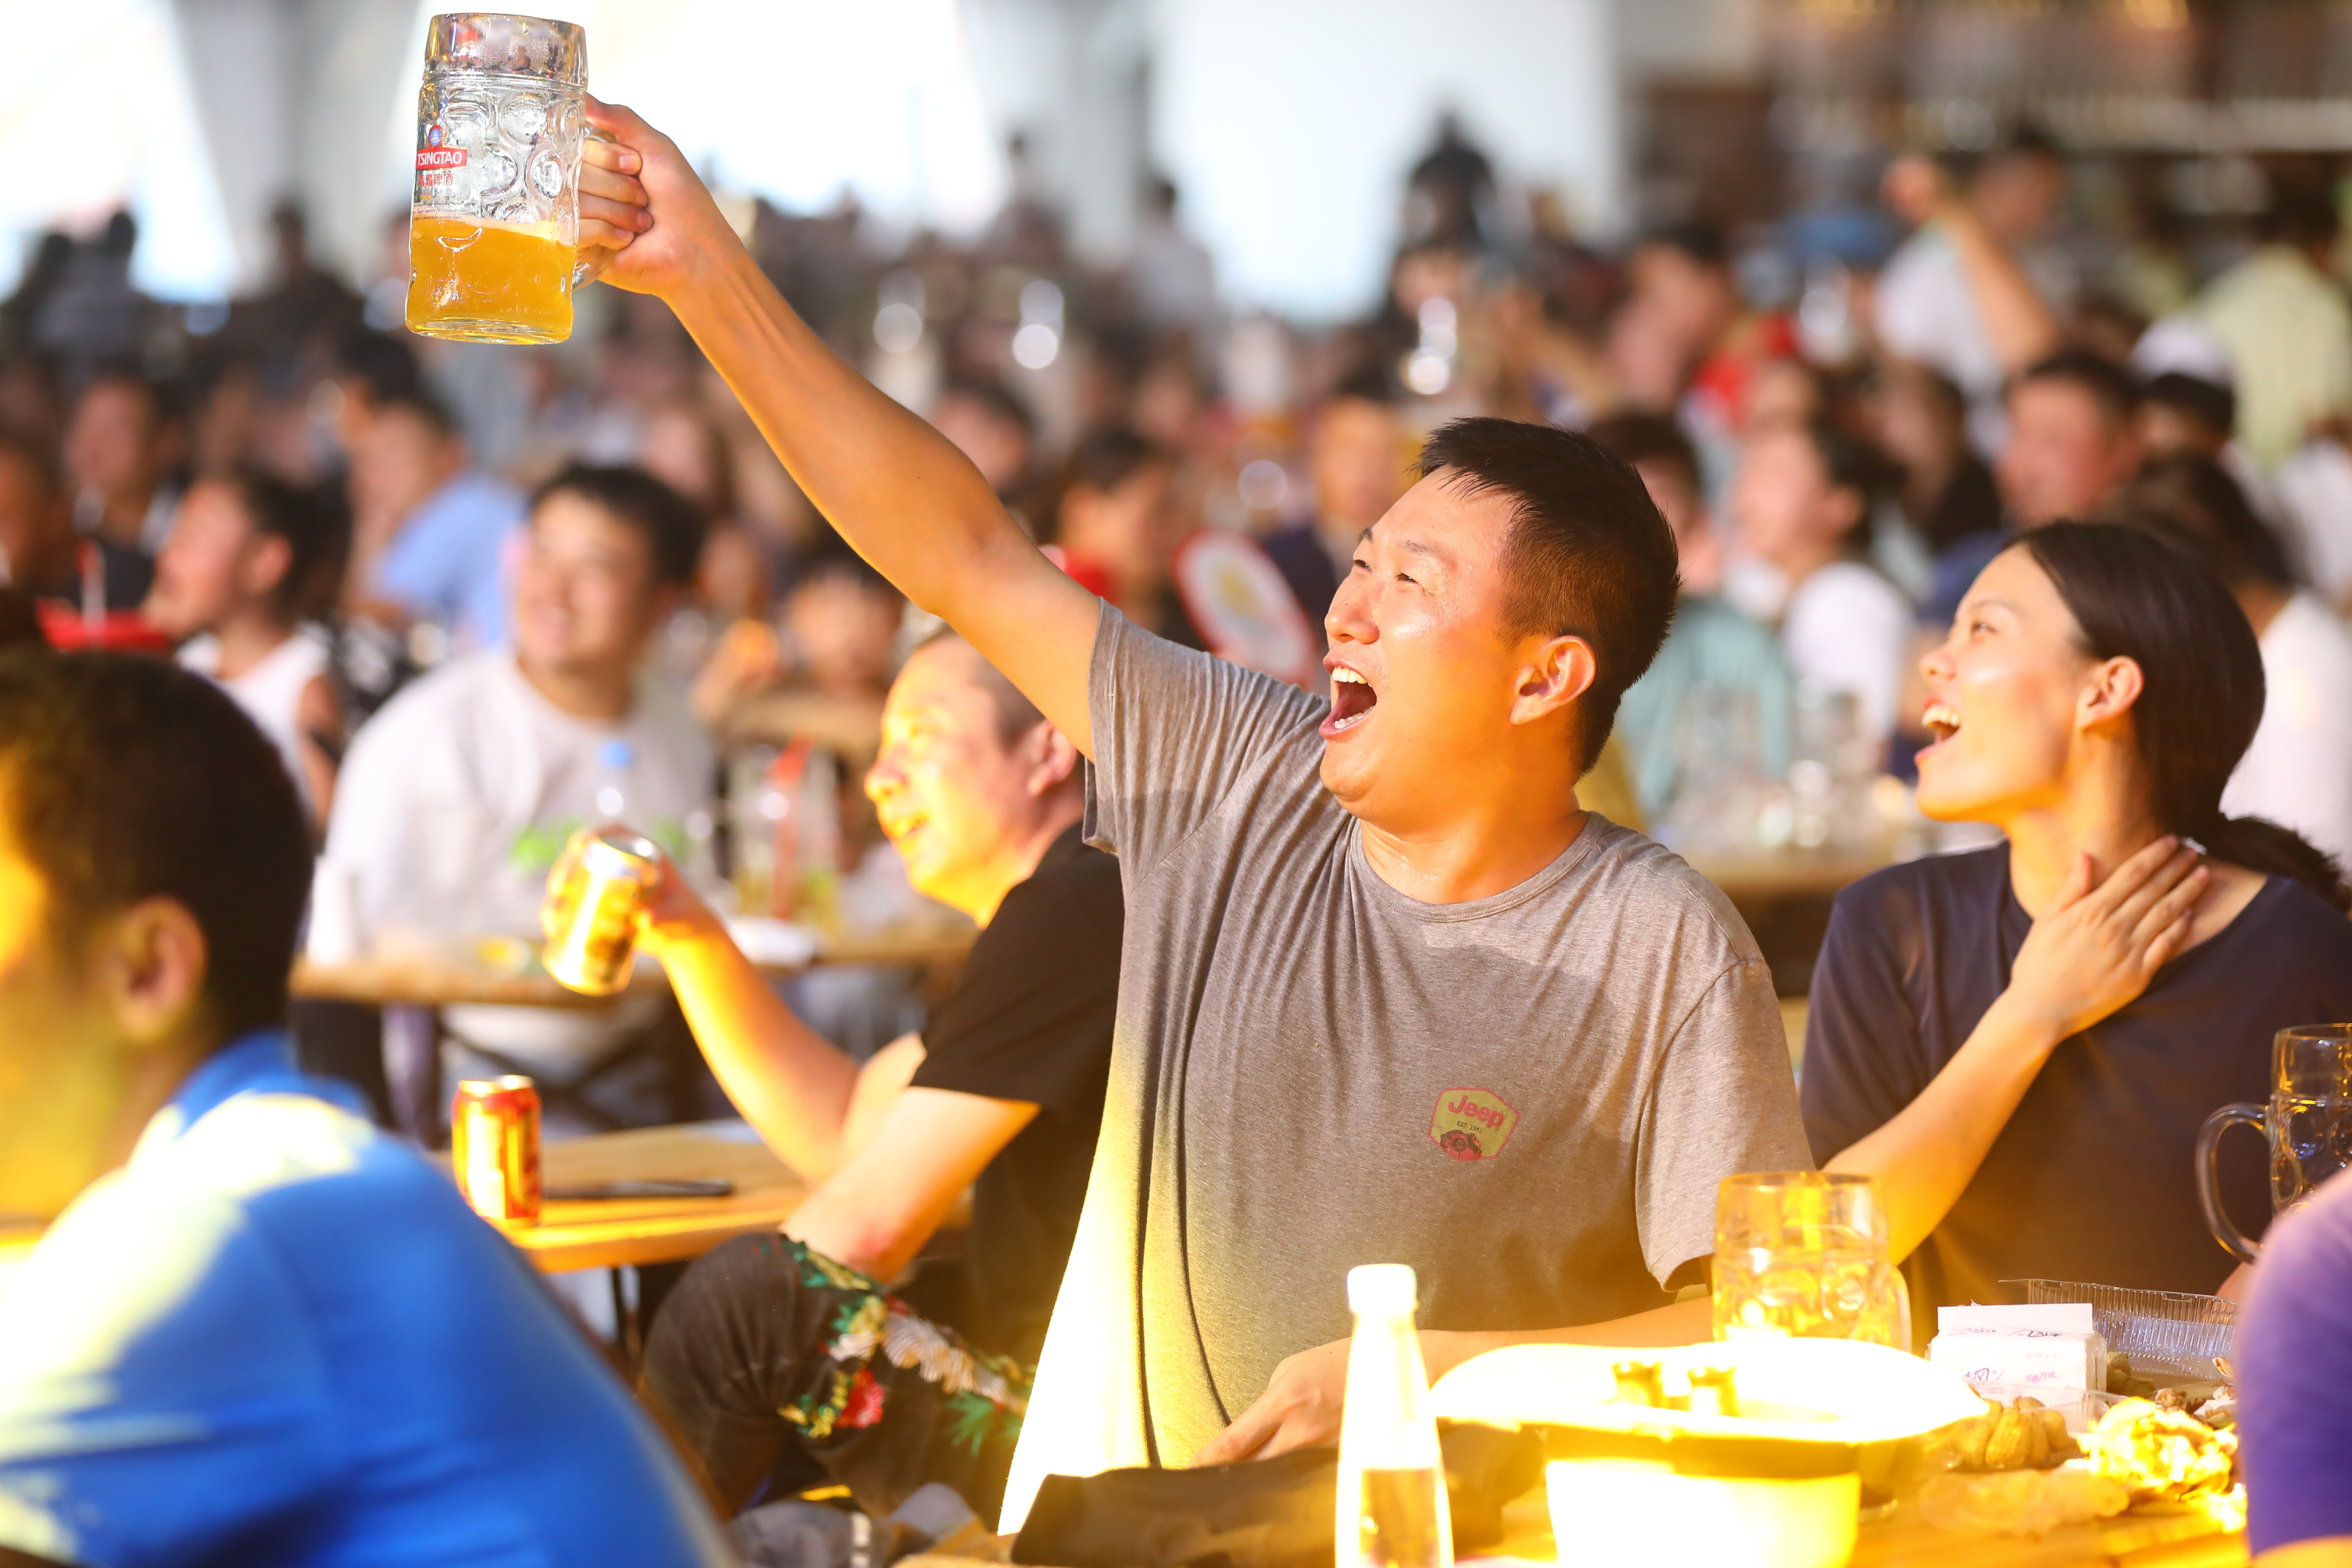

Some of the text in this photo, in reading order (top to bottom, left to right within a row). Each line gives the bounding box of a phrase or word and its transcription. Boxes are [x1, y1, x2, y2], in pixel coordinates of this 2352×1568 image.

[417, 151, 463, 166] TSINGTAO
[1448, 1094, 1505, 1129] Jeep
[1456, 1120, 1483, 1134] EST. 1941
